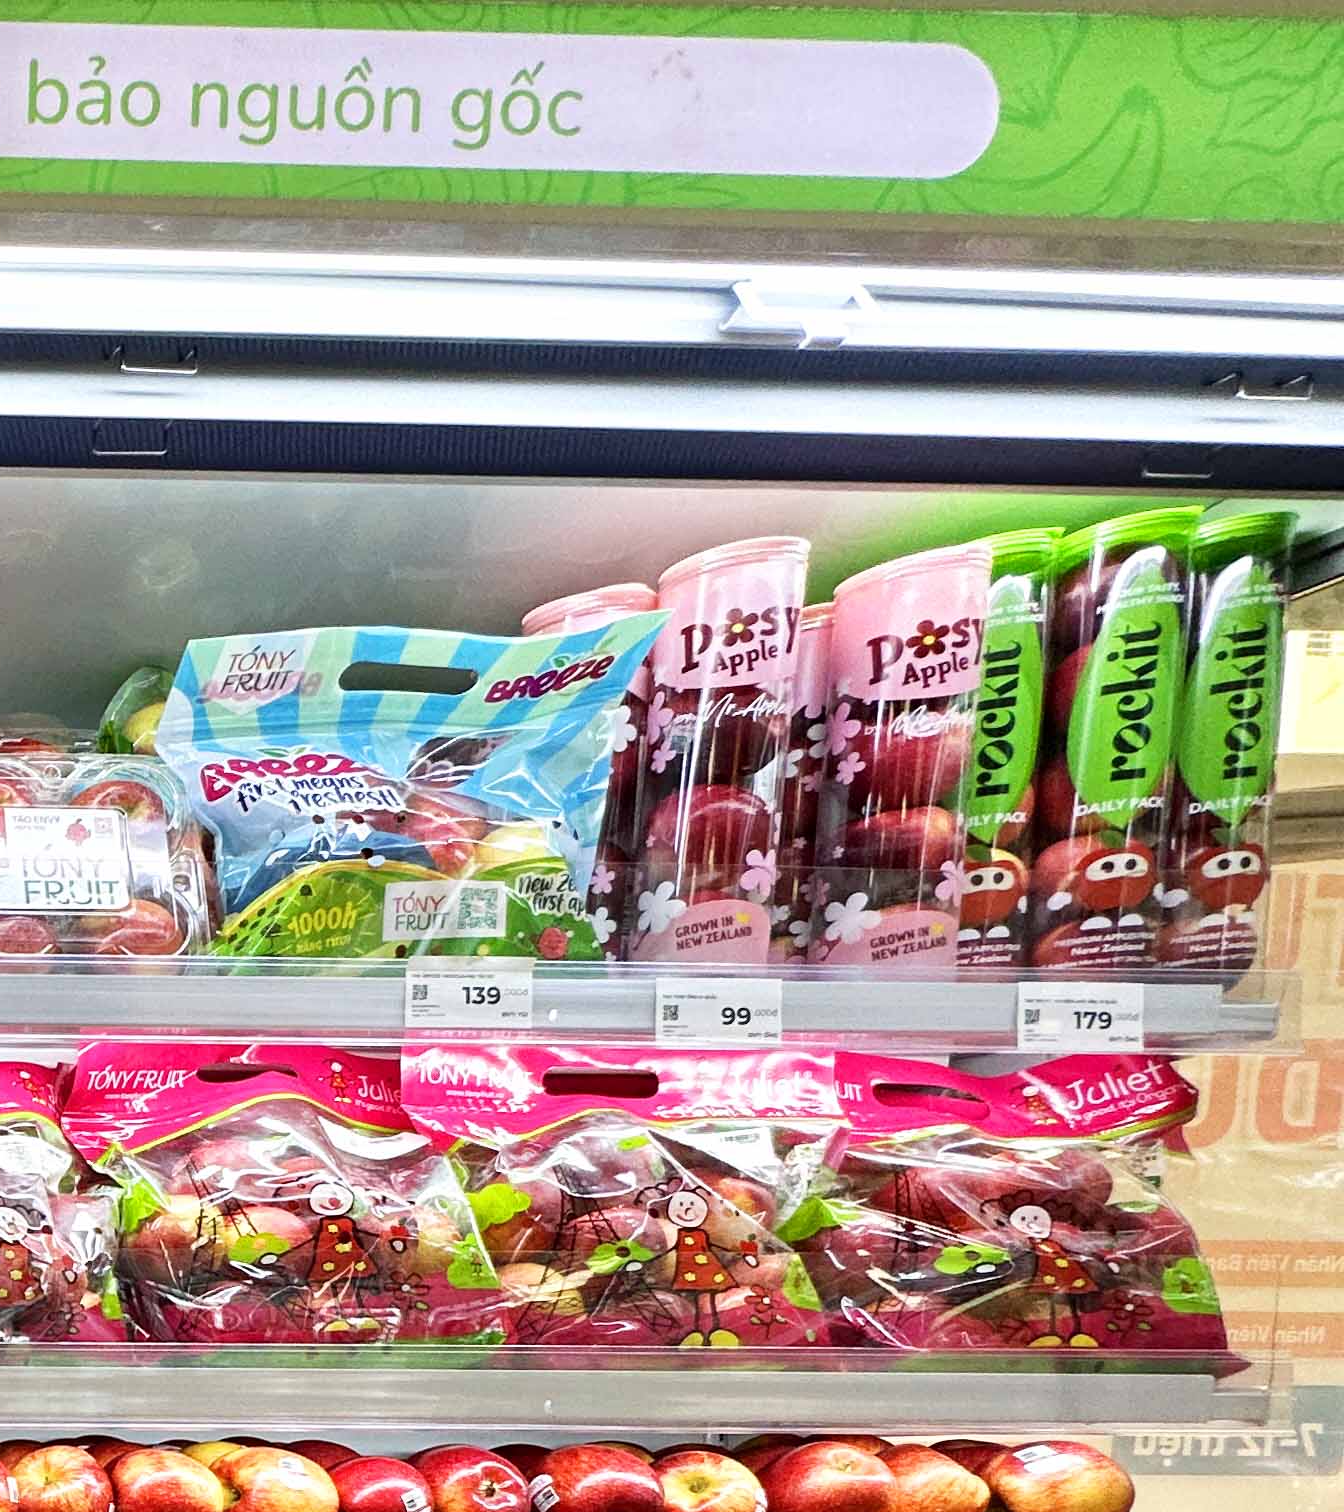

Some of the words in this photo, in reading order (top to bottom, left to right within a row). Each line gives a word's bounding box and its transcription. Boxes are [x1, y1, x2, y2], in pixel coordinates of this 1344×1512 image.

[27, 54, 162, 129] bảo
[189, 60, 422, 145] nguồn
[450, 62, 582, 152] gốc
[228, 644, 296, 672] TÓNY
[712, 645, 779, 675] Apple
[902, 653, 969, 688] Apple
[220, 671, 294, 695] FRUIT
[1109, 620, 1162, 782] rockit
[1222, 619, 1270, 780] rockit
[976, 638, 1023, 798] rockit
[1075, 798, 1126, 819] DAILY
[392, 892, 446, 915] TÓNY
[393, 913, 449, 935] FRUIT
[675, 920, 718, 938] GROWN
[721, 916, 734, 926] IN
[676, 937, 708, 951] NEW
[711, 925, 752, 944] ZEALAND
[1066, 1061, 1163, 1113] Juliet
